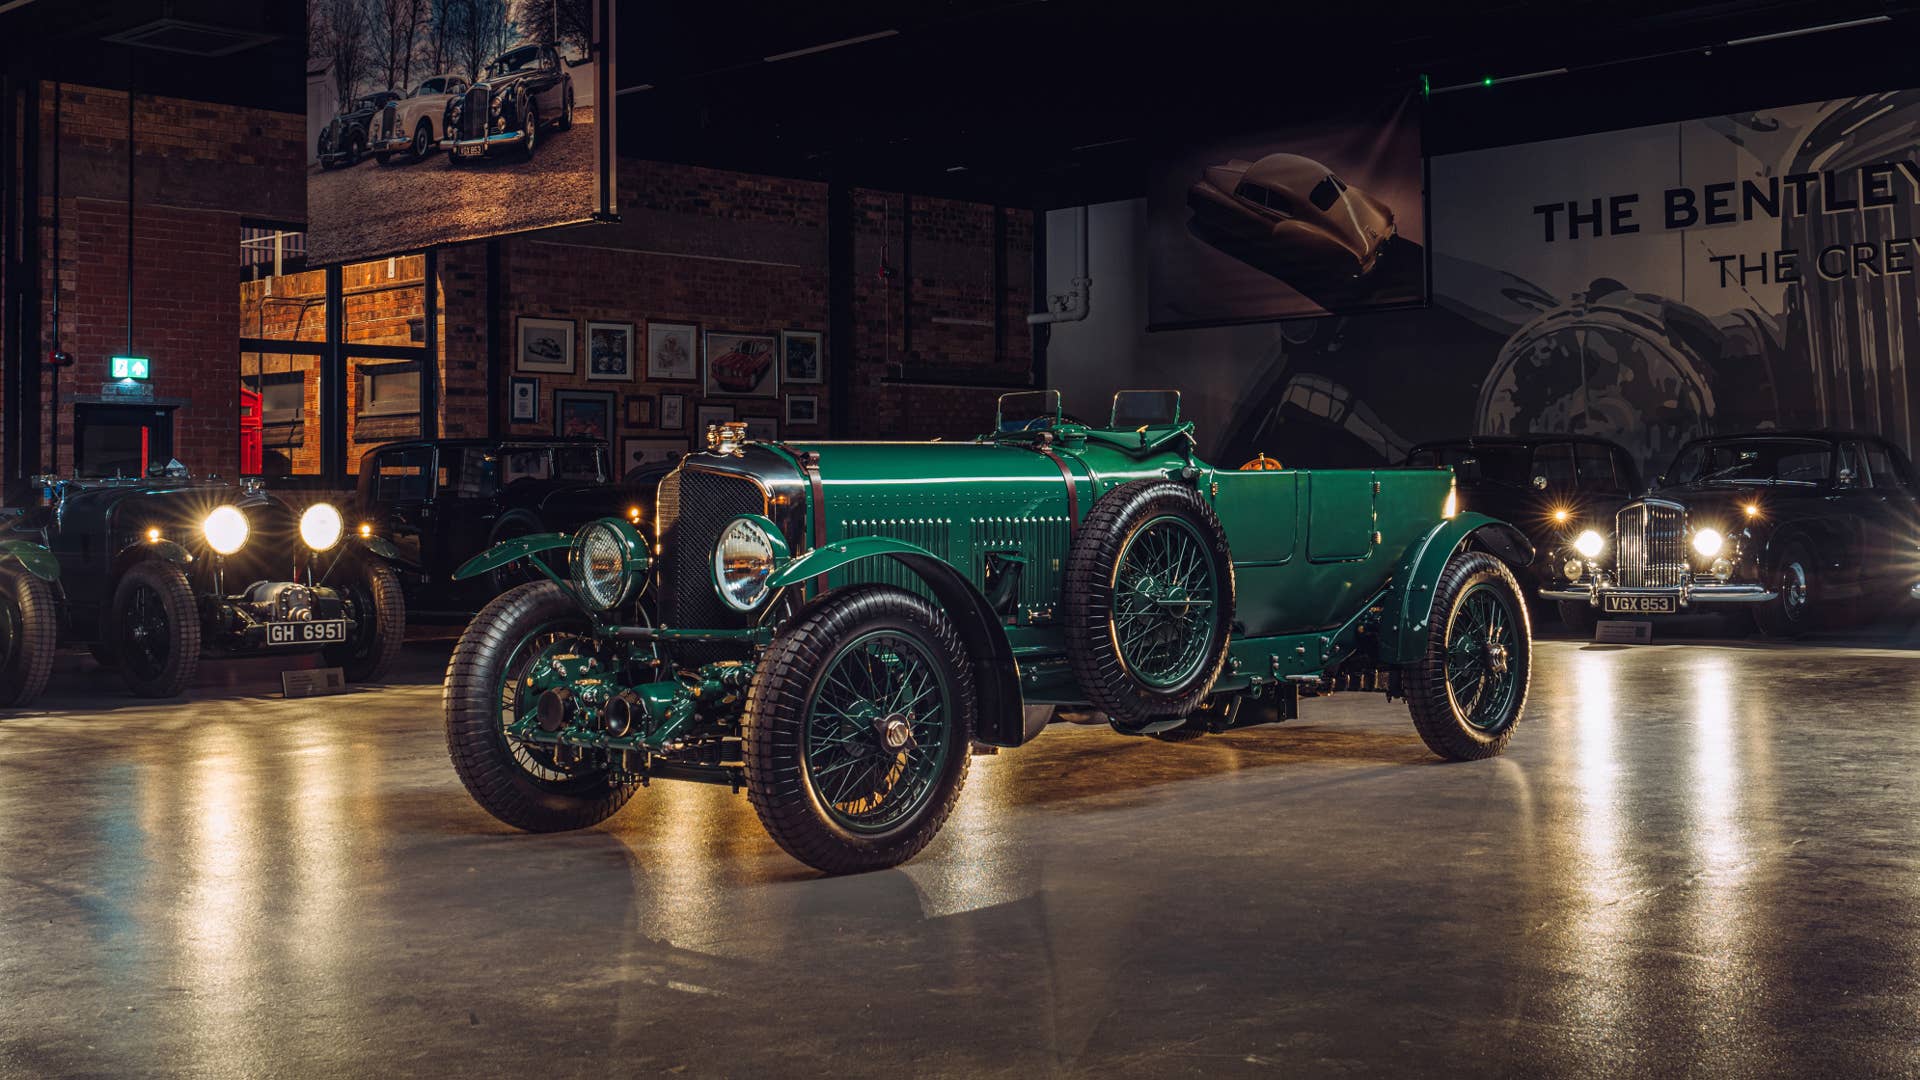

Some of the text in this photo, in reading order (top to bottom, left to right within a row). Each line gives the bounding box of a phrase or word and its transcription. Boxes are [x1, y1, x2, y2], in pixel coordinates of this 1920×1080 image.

[1534, 194, 1640, 242] THE
[1709, 237, 1920, 288] THE CRE
[1611, 597, 1669, 610] VGX 853
[271, 623, 342, 641] GH 6951
